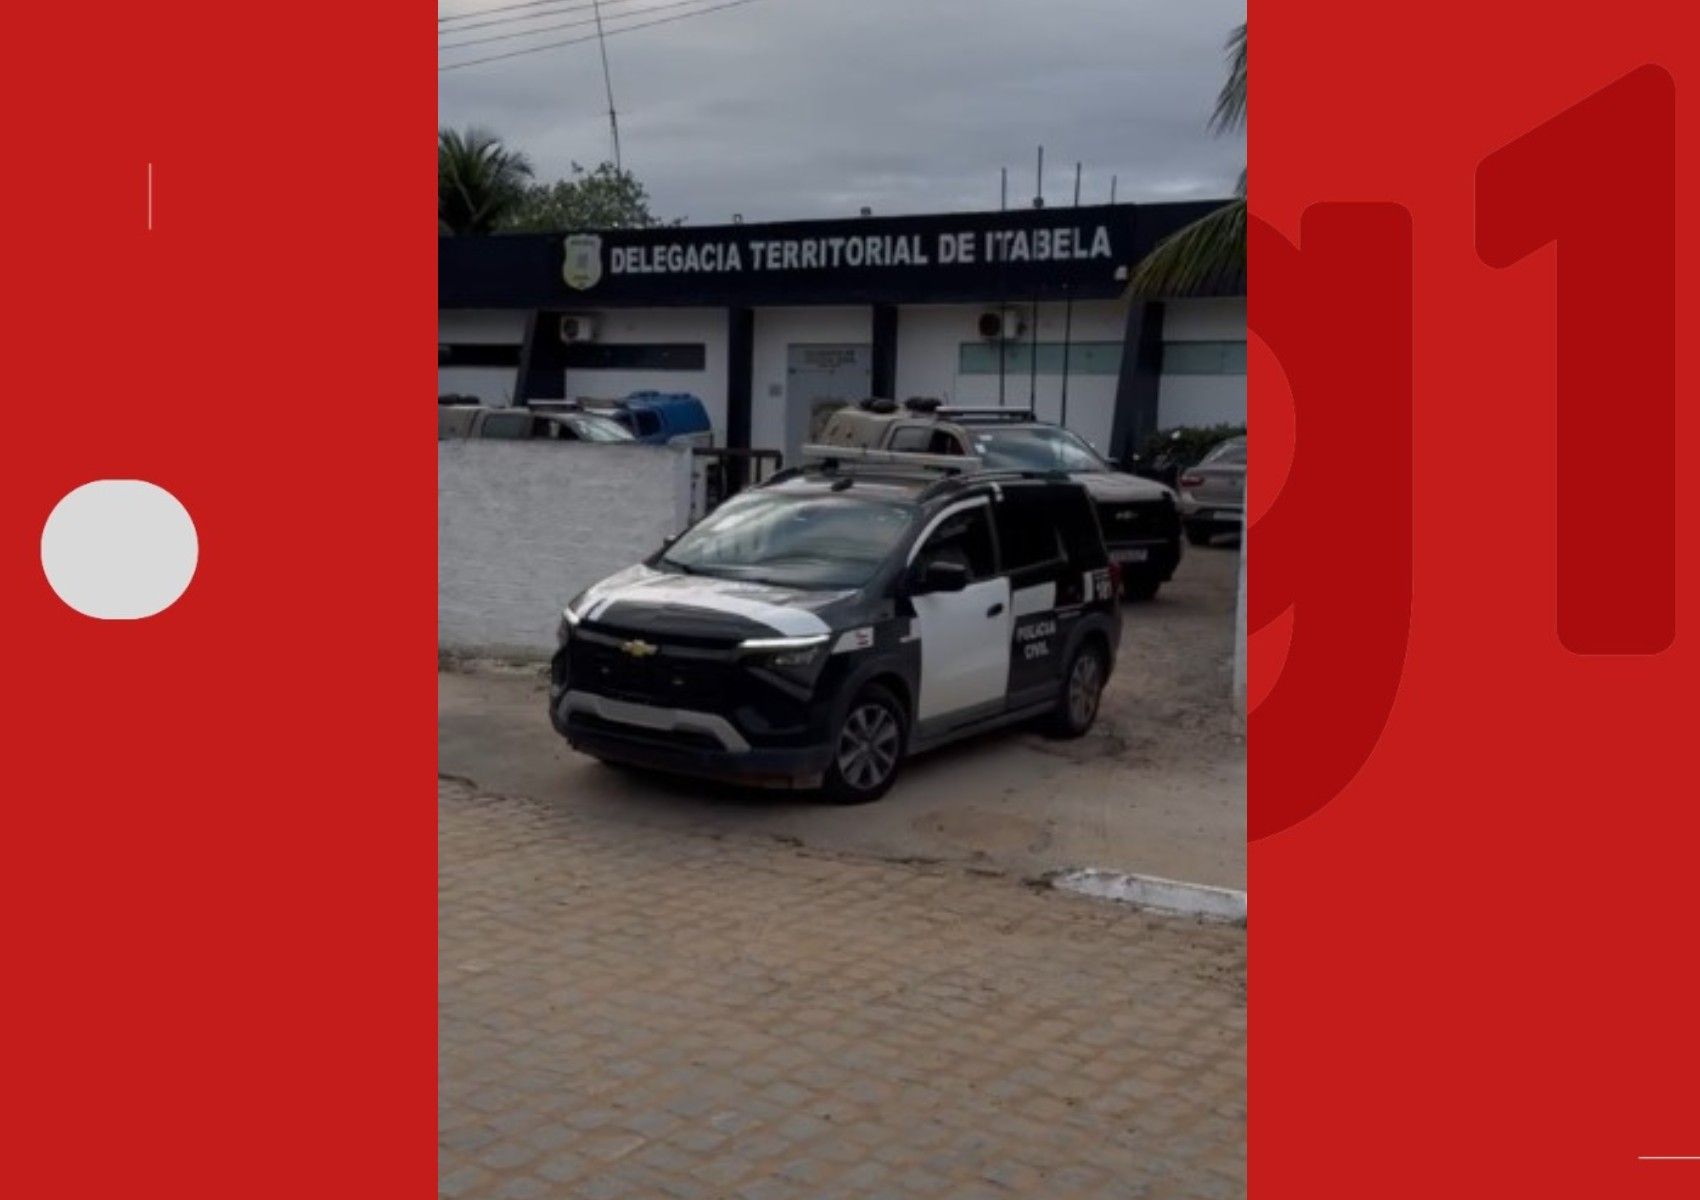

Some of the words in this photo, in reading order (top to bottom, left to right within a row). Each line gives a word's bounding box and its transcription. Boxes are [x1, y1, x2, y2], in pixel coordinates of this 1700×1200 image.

[610, 242, 742, 273] DELEGACIA
[750, 235, 928, 270] TERRITORIAL
[938, 232, 976, 264] DE
[985, 225, 1112, 263] ITABELA
[1024, 640, 1049, 660] CIVIL
